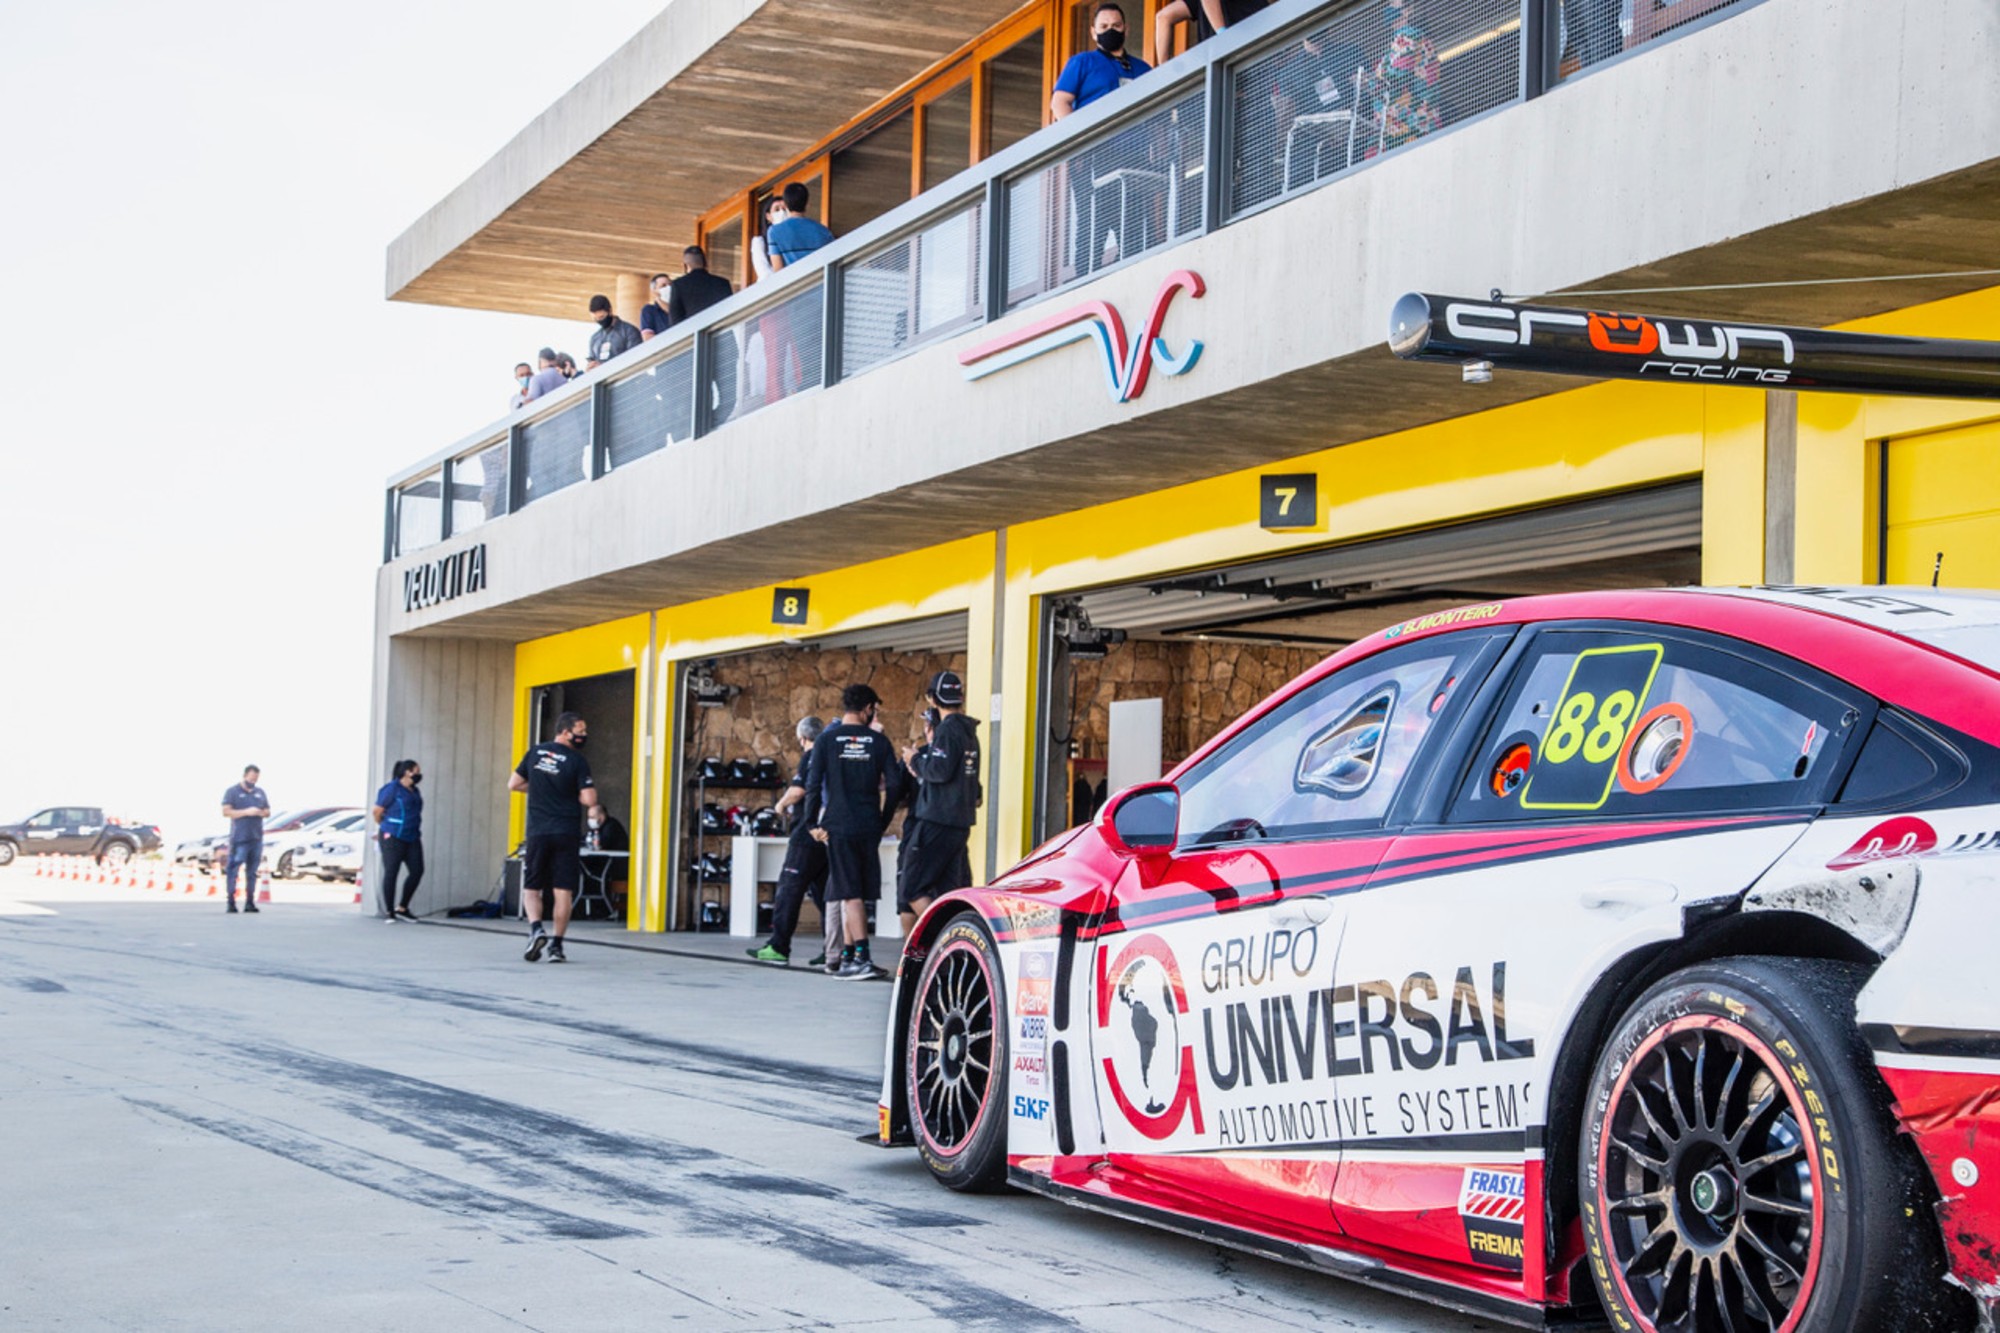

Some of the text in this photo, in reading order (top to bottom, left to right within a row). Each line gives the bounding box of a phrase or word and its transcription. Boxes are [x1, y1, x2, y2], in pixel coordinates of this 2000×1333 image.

[1640, 360, 1791, 382] racing
[1275, 487, 1297, 516] 7
[782, 596, 798, 617] 8
[1403, 603, 1502, 635] B.MONTEIRO
[1544, 689, 1635, 764] 88
[1202, 926, 1318, 993] GRUPO
[1203, 961, 1536, 1091] UNIVERSAL
[1014, 1096, 1050, 1120] SKF
[1219, 1096, 1378, 1145] AUTOMOTIVE
[1469, 1230, 1524, 1258] FREMA
